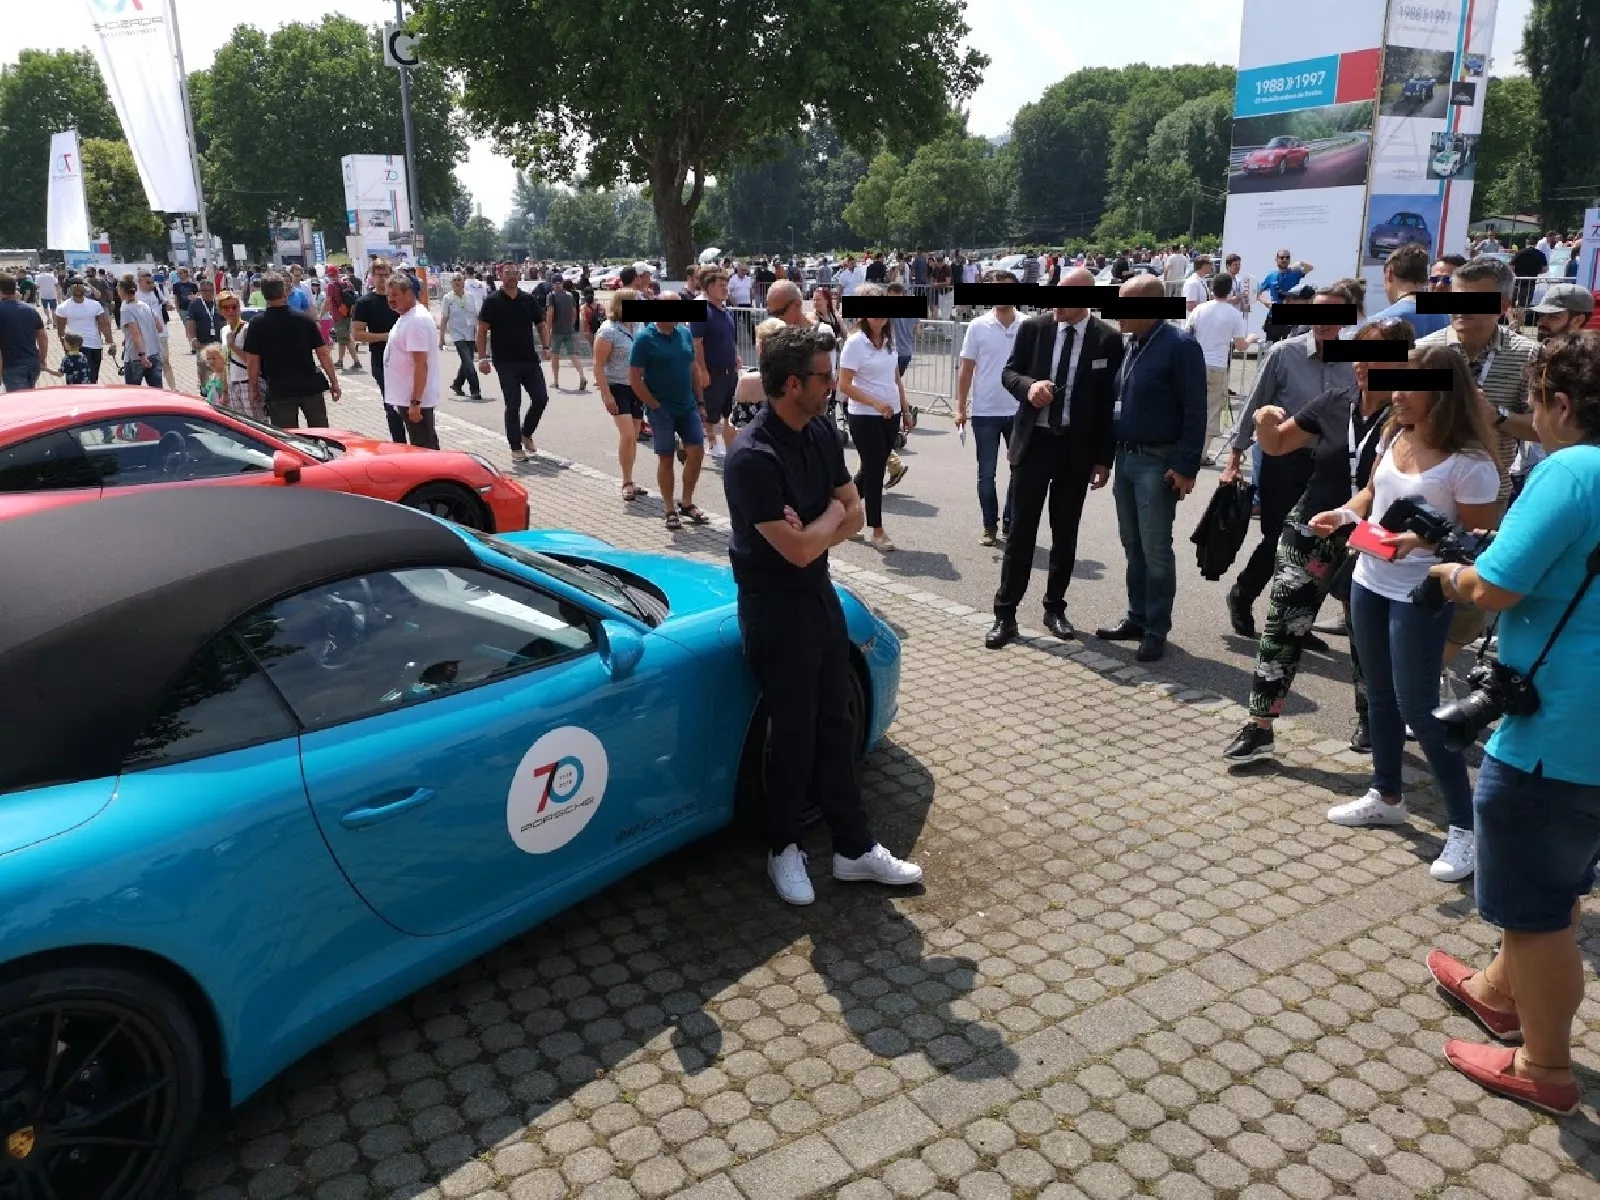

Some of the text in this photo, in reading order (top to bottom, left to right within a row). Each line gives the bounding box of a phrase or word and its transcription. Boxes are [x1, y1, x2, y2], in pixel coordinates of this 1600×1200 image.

[389, 30, 418, 66] C
[534, 755, 584, 814] 70
[521, 796, 594, 833] PORSCHE
